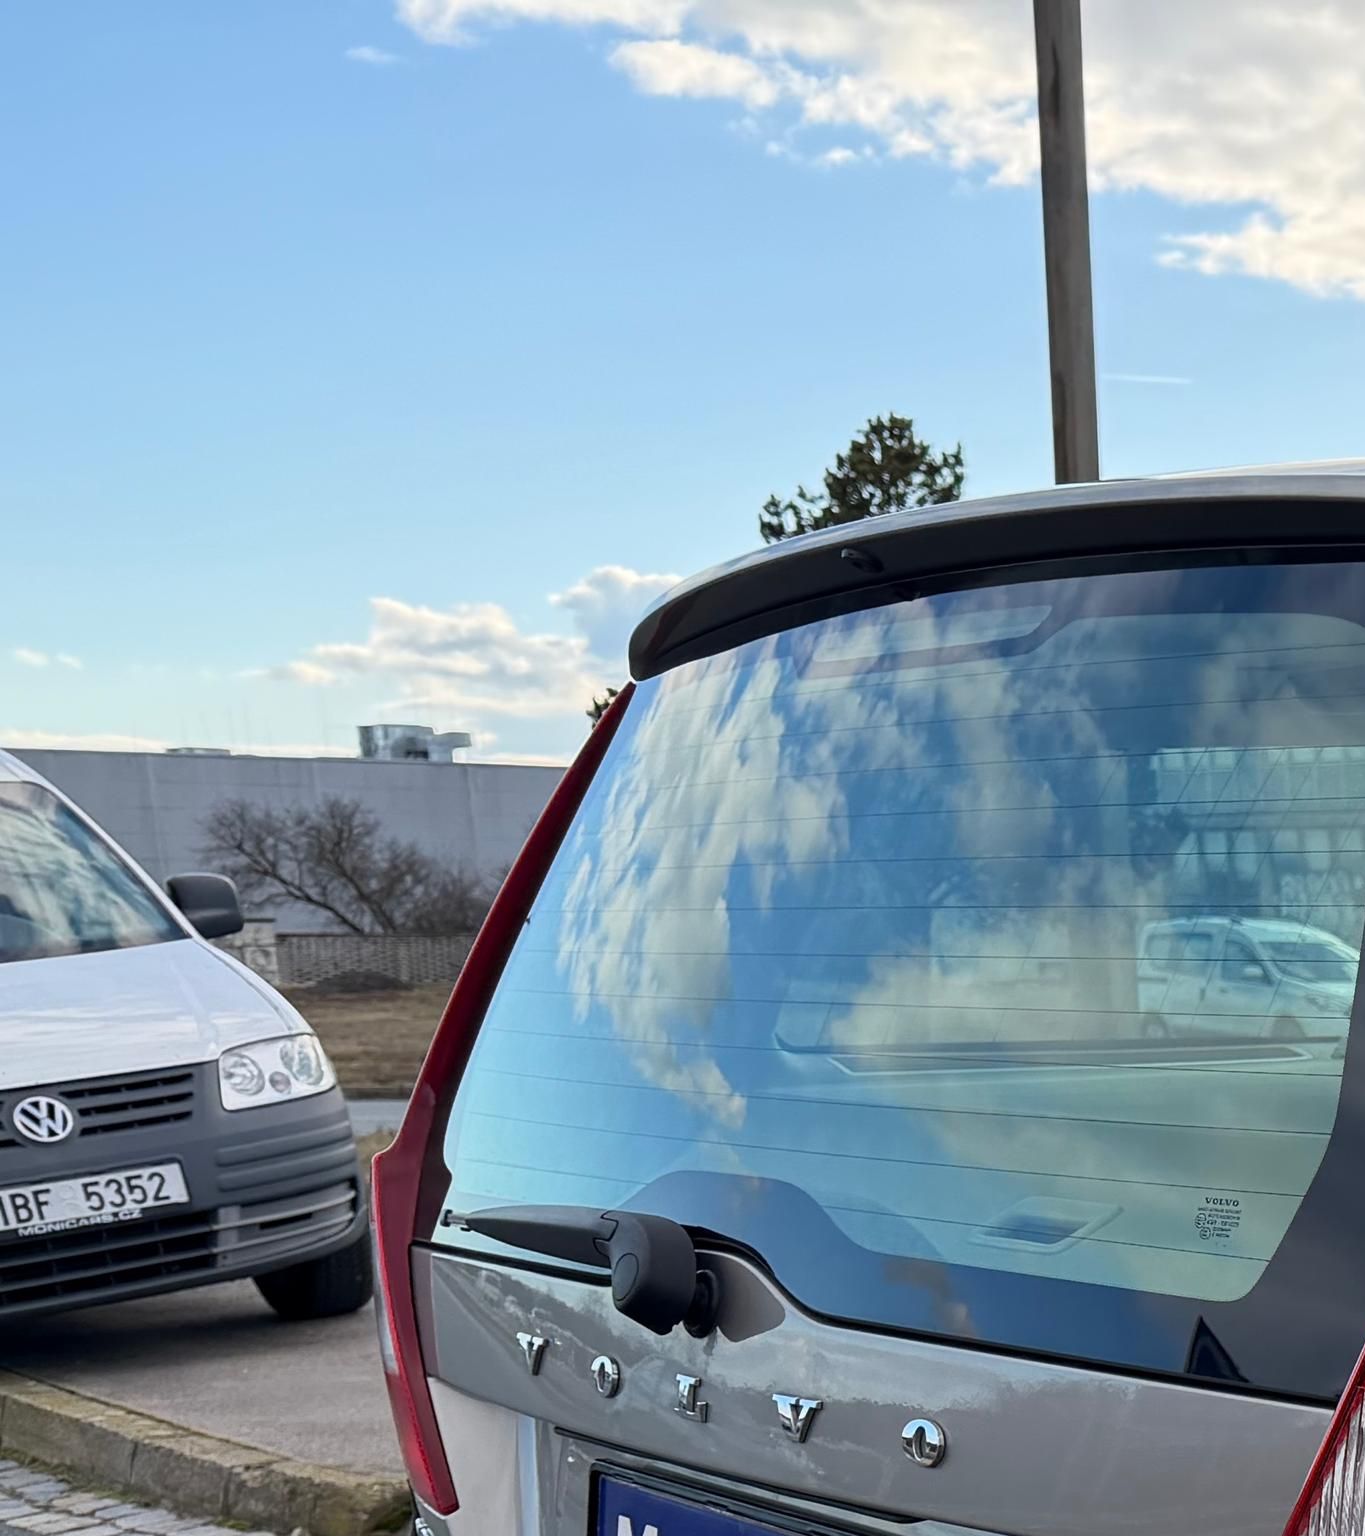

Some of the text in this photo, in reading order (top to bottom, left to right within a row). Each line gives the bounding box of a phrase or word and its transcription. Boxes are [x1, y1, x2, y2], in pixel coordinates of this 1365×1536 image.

[81, 1172, 171, 1212] 5352
[1205, 1197, 1239, 1207] VOLVO
[18, 1209, 143, 1237] MONICARS.CZ
[515, 1330, 946, 1468] VOLVO
